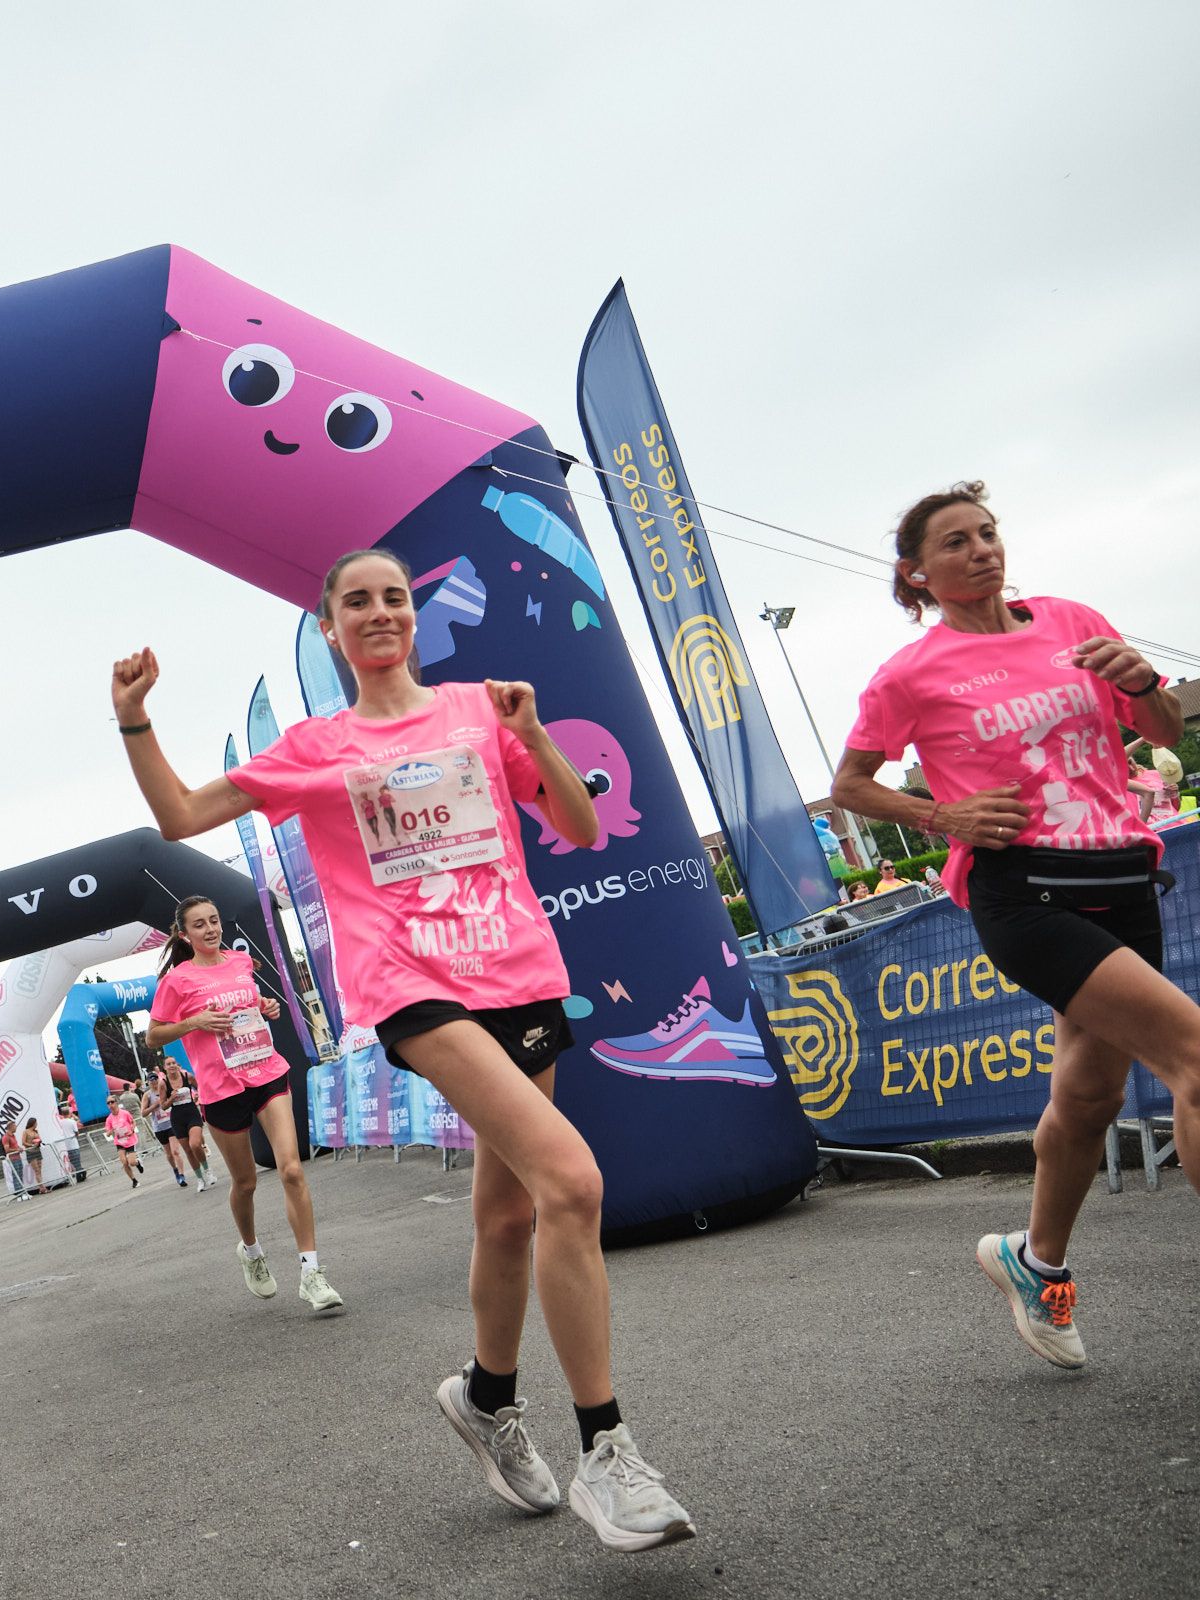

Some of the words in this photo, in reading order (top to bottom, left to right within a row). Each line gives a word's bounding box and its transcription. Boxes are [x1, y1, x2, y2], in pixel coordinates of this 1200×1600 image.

[641, 423, 707, 589] Express
[613, 442, 677, 603] Correos
[950, 669, 1008, 696] OYSHO
[391, 770, 440, 786] ASTURIANA
[401, 805, 451, 831] 016
[419, 829, 443, 841] 4922
[385, 844, 414, 859] CARRERA
[414, 843, 423, 852] DE
[424, 841, 433, 850] LA
[434, 837, 456, 849] MUJER
[450, 848, 489, 862] Santander
[384, 858, 425, 877] OYSHO
[628, 858, 708, 892] energy
[411, 914, 509, 957] MUJER
[449, 957, 484, 977] 2026
[878, 954, 1021, 1020] Corre
[206, 989, 254, 1011] CARRERA
[236, 1032, 257, 1045] 016
[526, 1026, 544, 1040] NIKE
[881, 1024, 1055, 1106] Express
